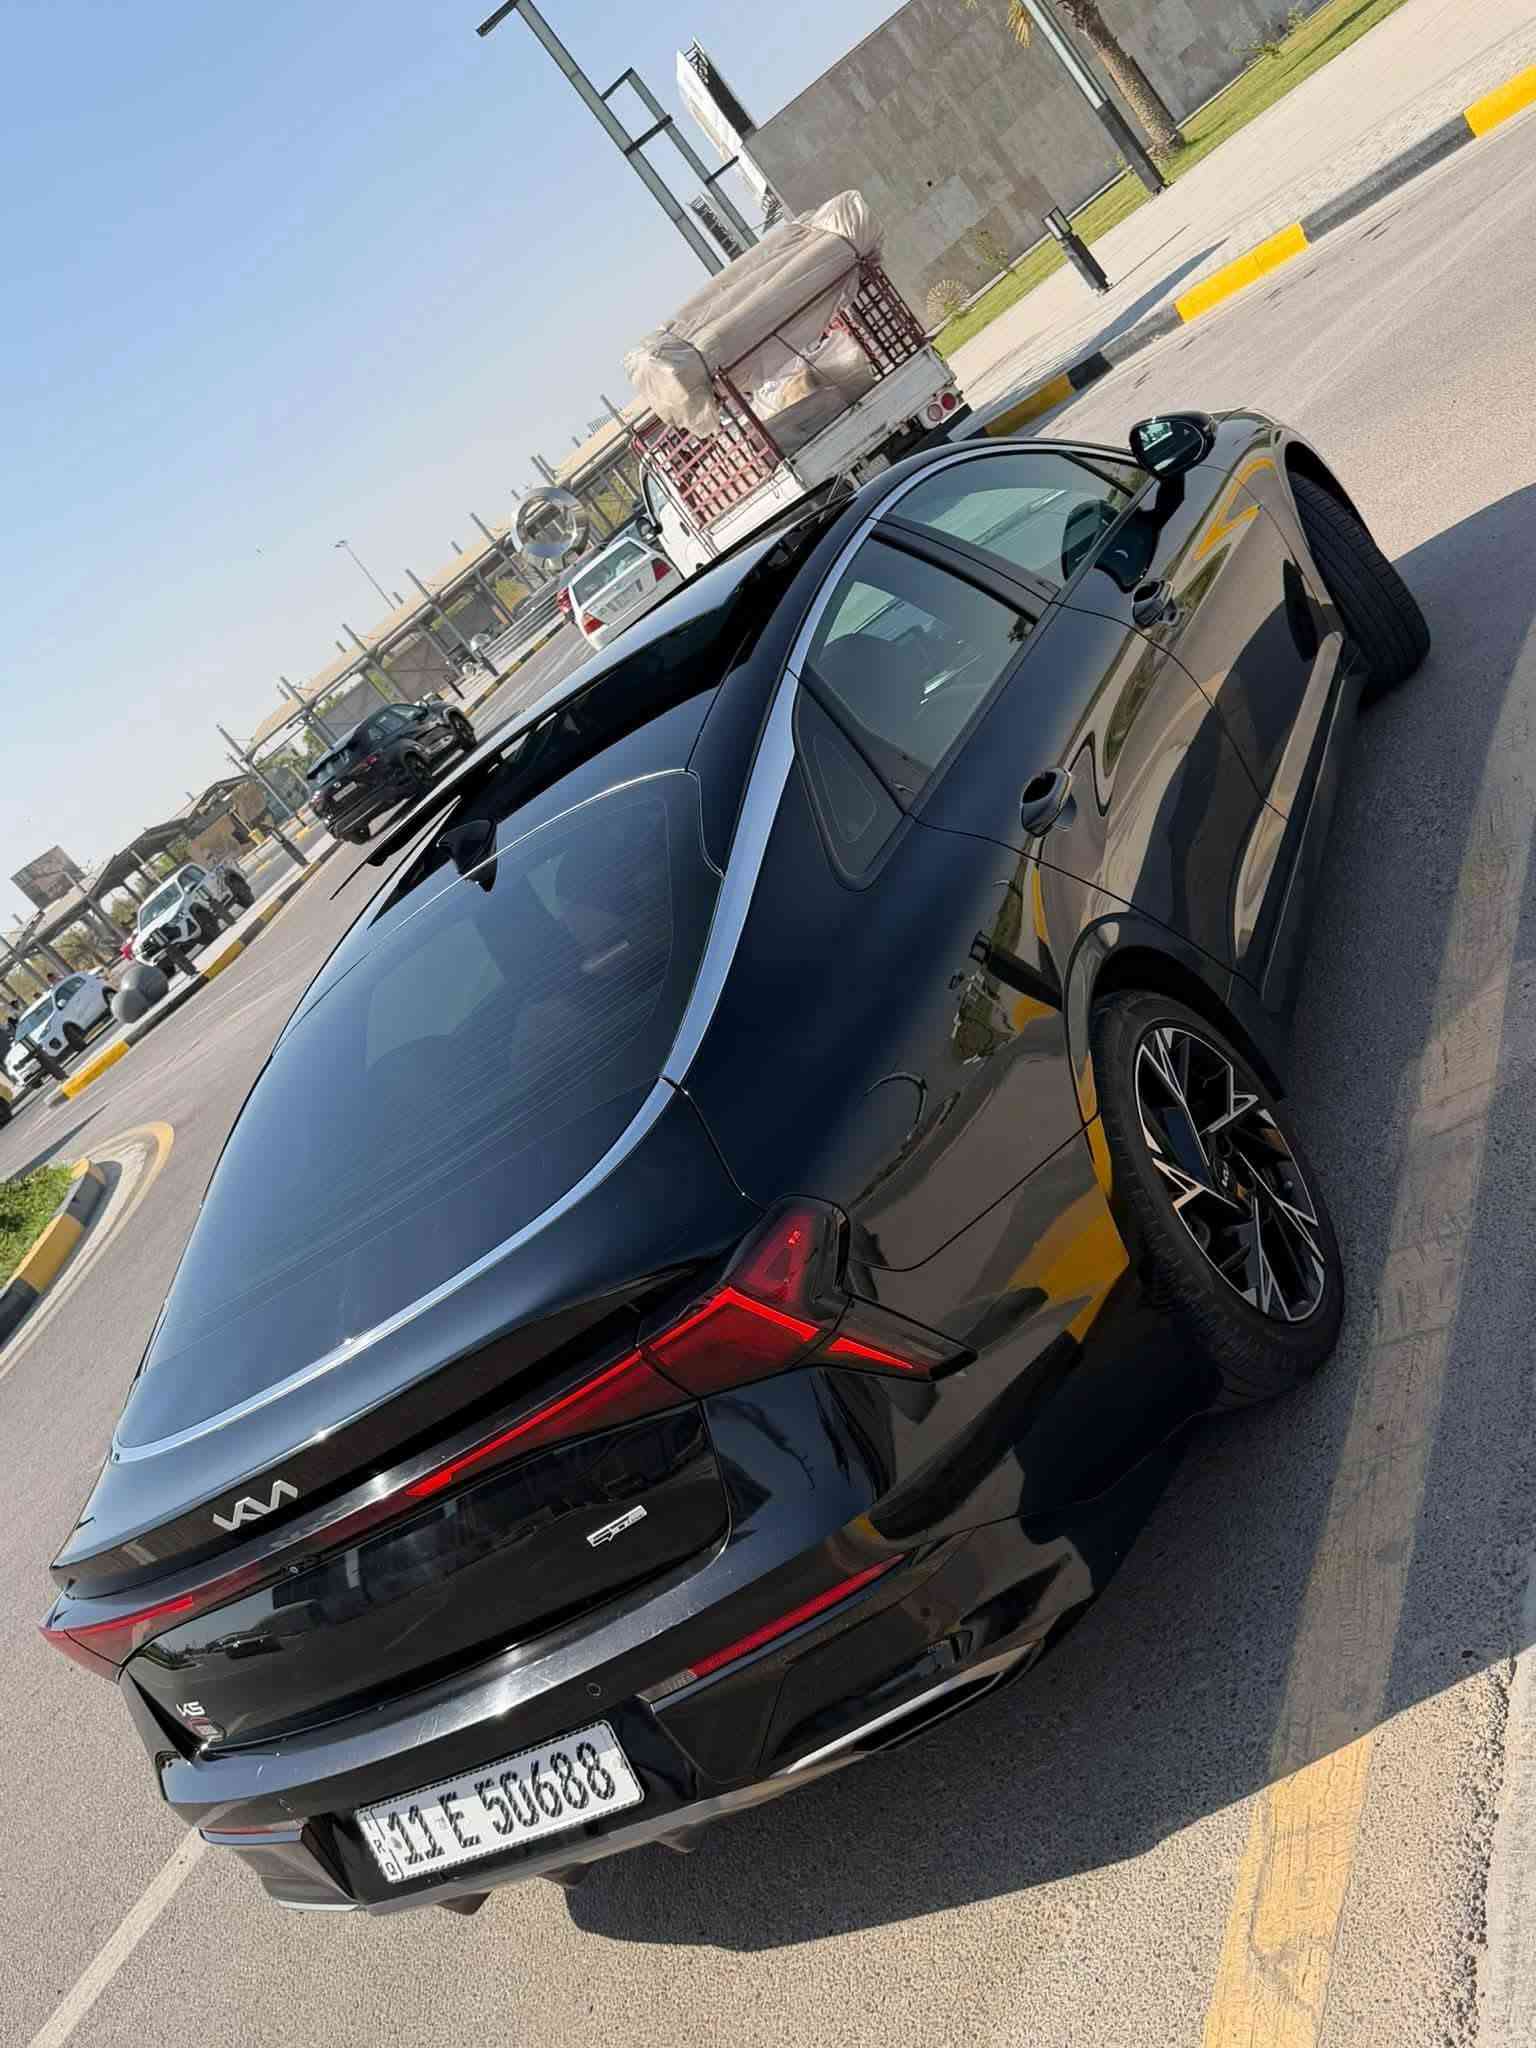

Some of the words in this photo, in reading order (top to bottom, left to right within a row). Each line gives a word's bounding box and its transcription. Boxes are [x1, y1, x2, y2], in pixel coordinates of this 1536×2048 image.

[213, 1480, 298, 1531] KIA
[175, 1701, 206, 1717] K5
[387, 1804, 446, 1866] 11
[438, 1791, 482, 1850] E
[474, 1741, 616, 1836] 50688
